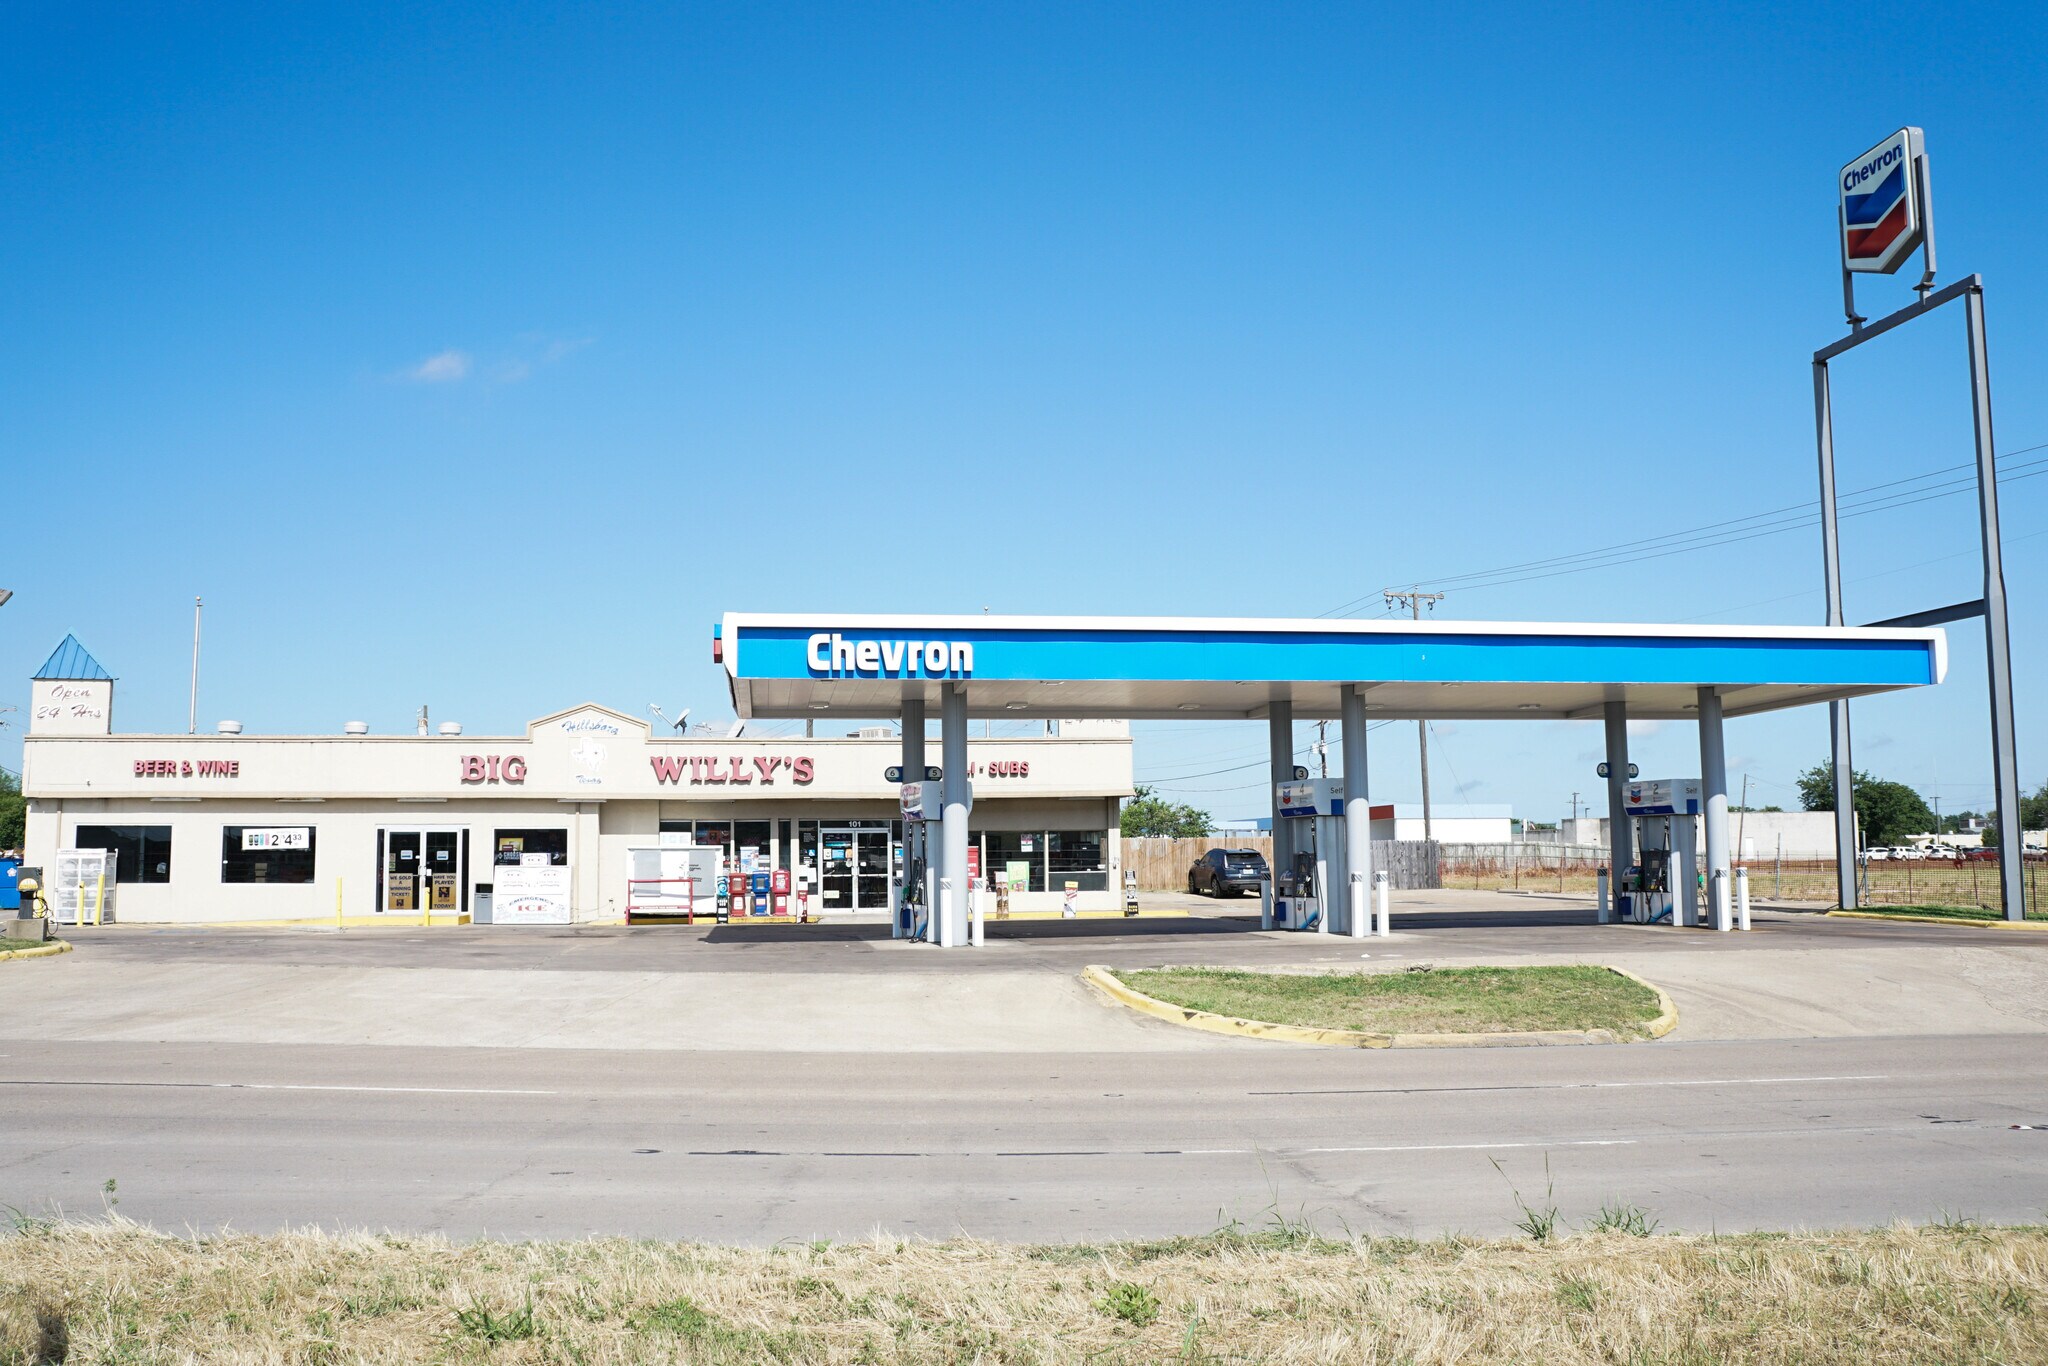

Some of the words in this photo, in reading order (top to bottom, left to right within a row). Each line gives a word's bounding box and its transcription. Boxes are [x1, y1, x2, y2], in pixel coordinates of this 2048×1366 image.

[1844, 144, 1902, 191] Chevron
[807, 633, 973, 672] Chevron
[51, 685, 91, 701] Open
[36, 706, 61, 718] 24
[71, 704, 101, 718] Hrs
[133, 760, 177, 774] BEER
[181, 760, 192, 774] &
[197, 760, 239, 774] WINE
[460, 755, 527, 782] BIG
[650, 756, 814, 783] WILLY'S
[889, 769, 896, 777] 6
[932, 769, 938, 777] 5
[989, 761, 1029, 774] SUBS
[1298, 770, 1305, 778] 3
[1653, 783, 1659, 795] 2
[271, 834, 279, 846] 2
[509, 897, 554, 906] EMERGENCY
